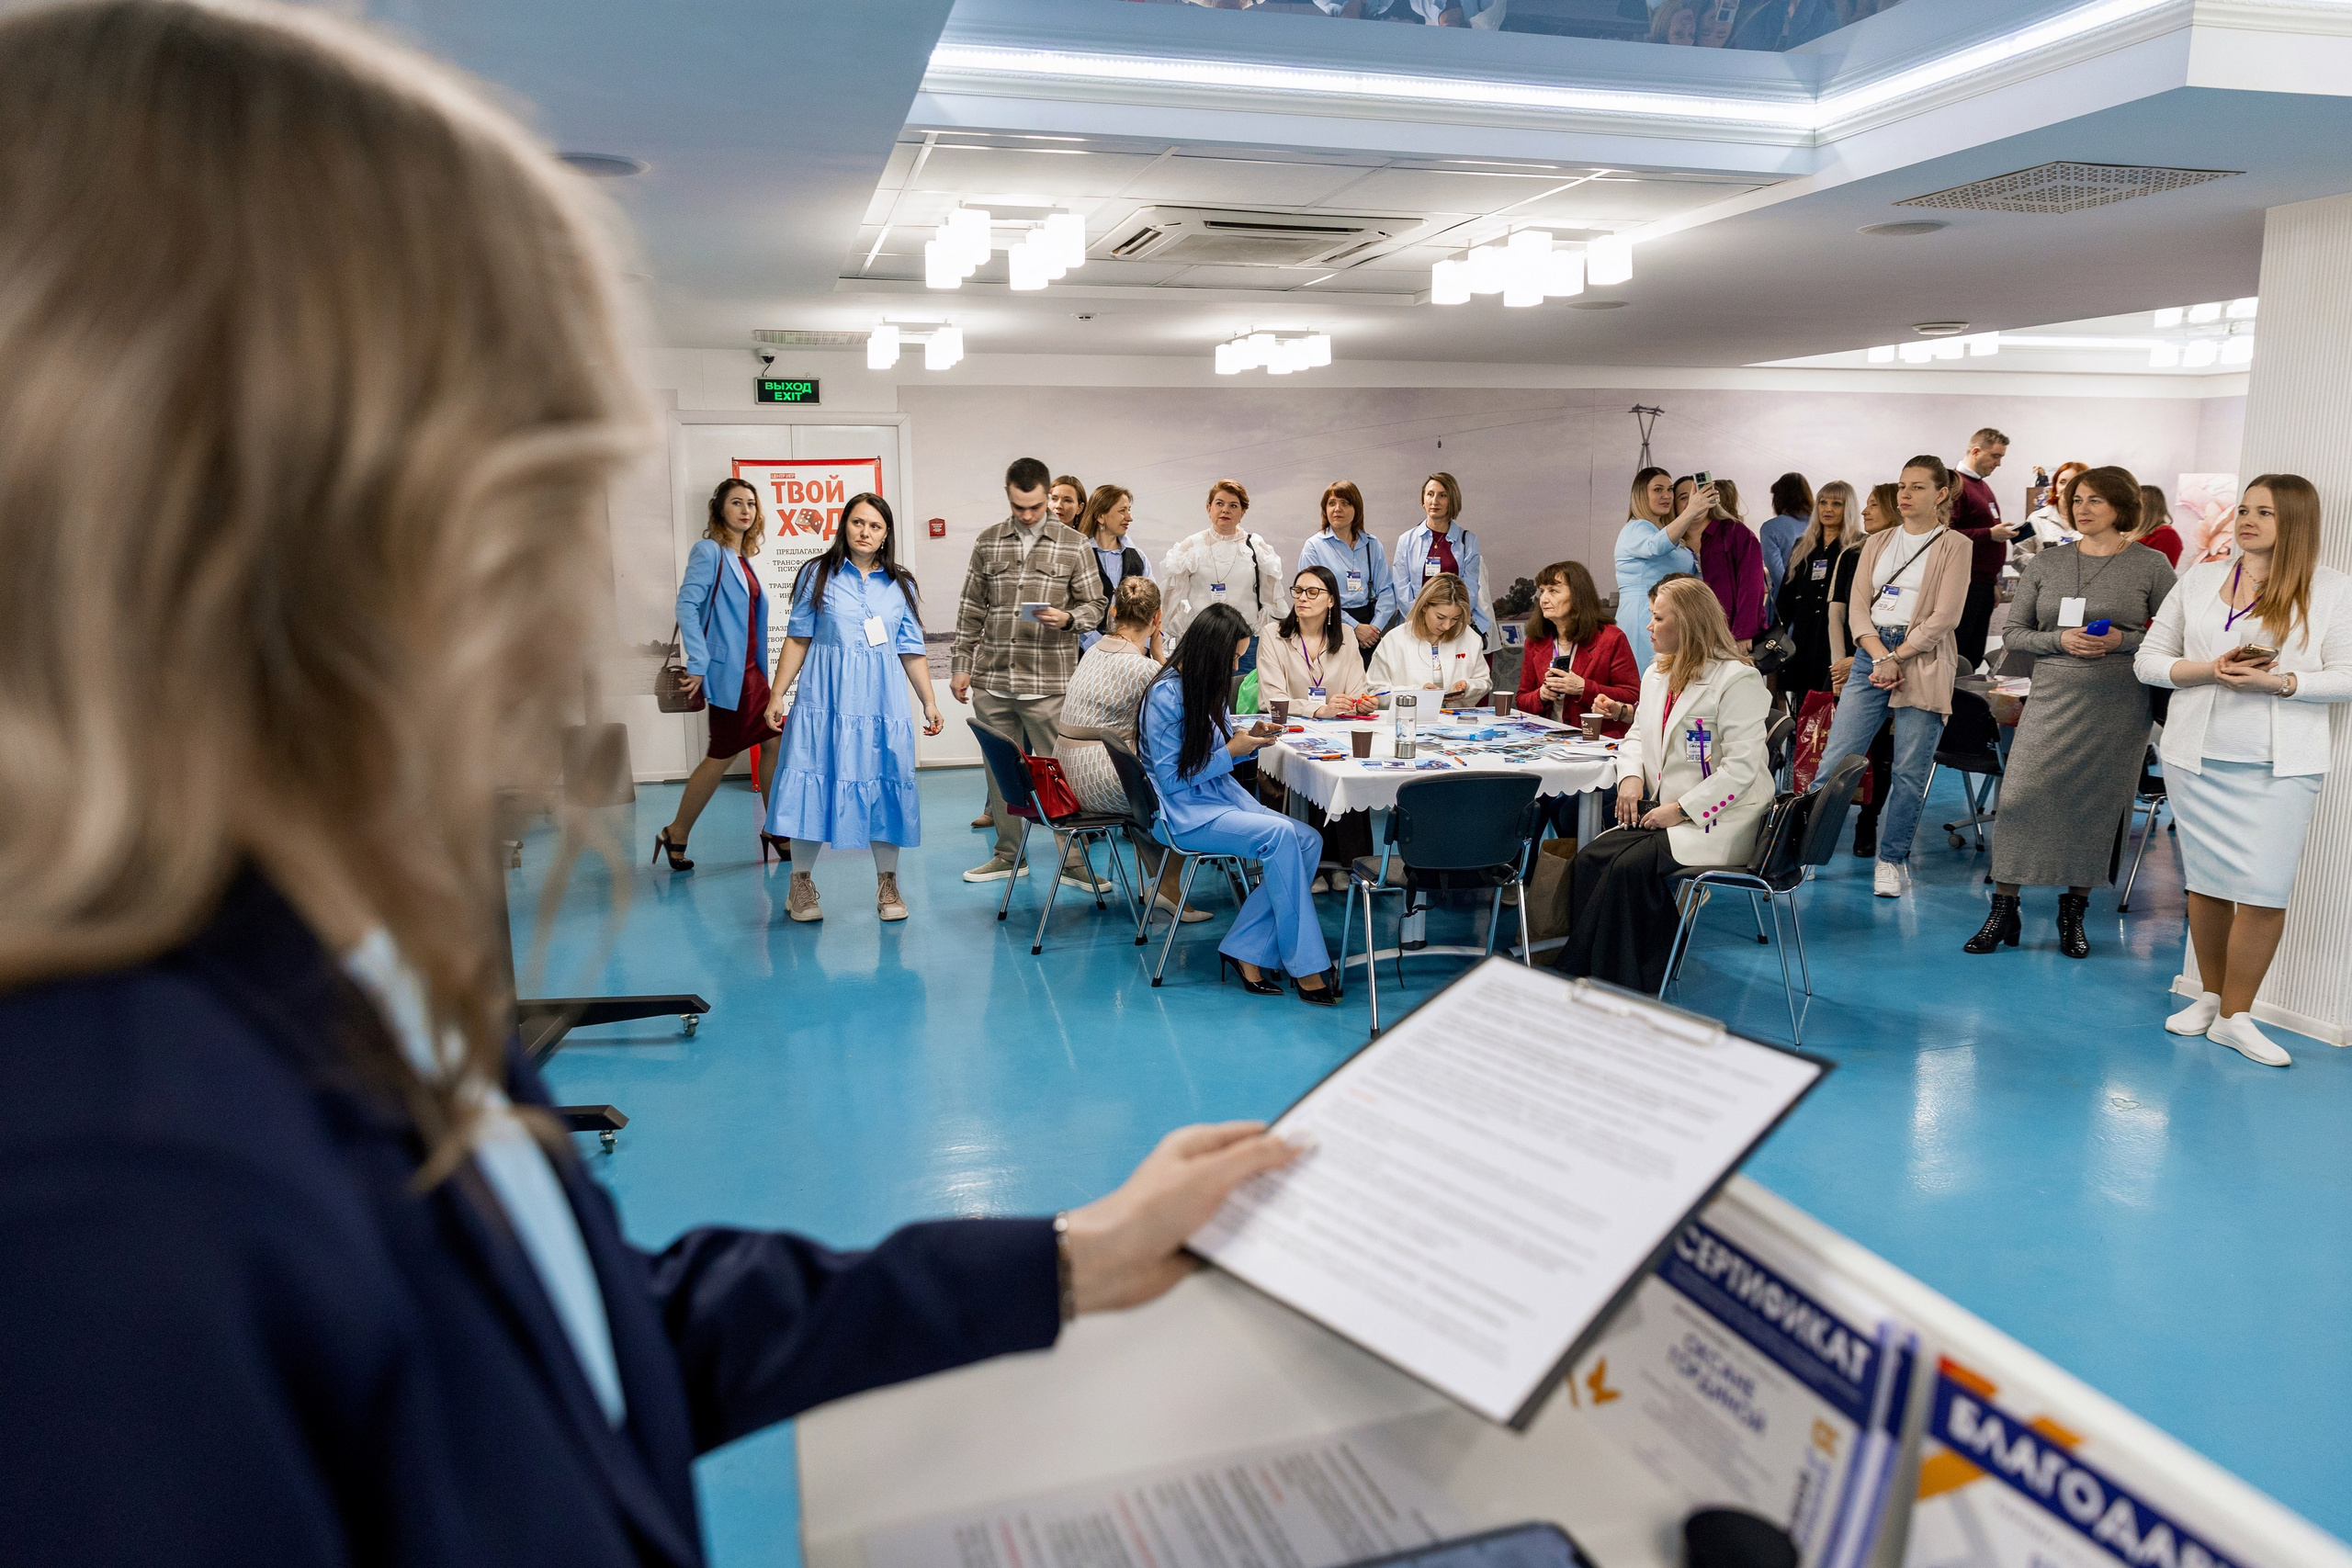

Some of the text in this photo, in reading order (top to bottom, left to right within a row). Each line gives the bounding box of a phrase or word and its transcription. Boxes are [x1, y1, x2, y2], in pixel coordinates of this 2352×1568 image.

[765, 381, 812, 393] ВЫХОД
[775, 391, 802, 400] EXIT
[771, 474, 844, 503] ТВОЙ
[1674, 1224, 1872, 1383] СЕРТИФИКАТ
